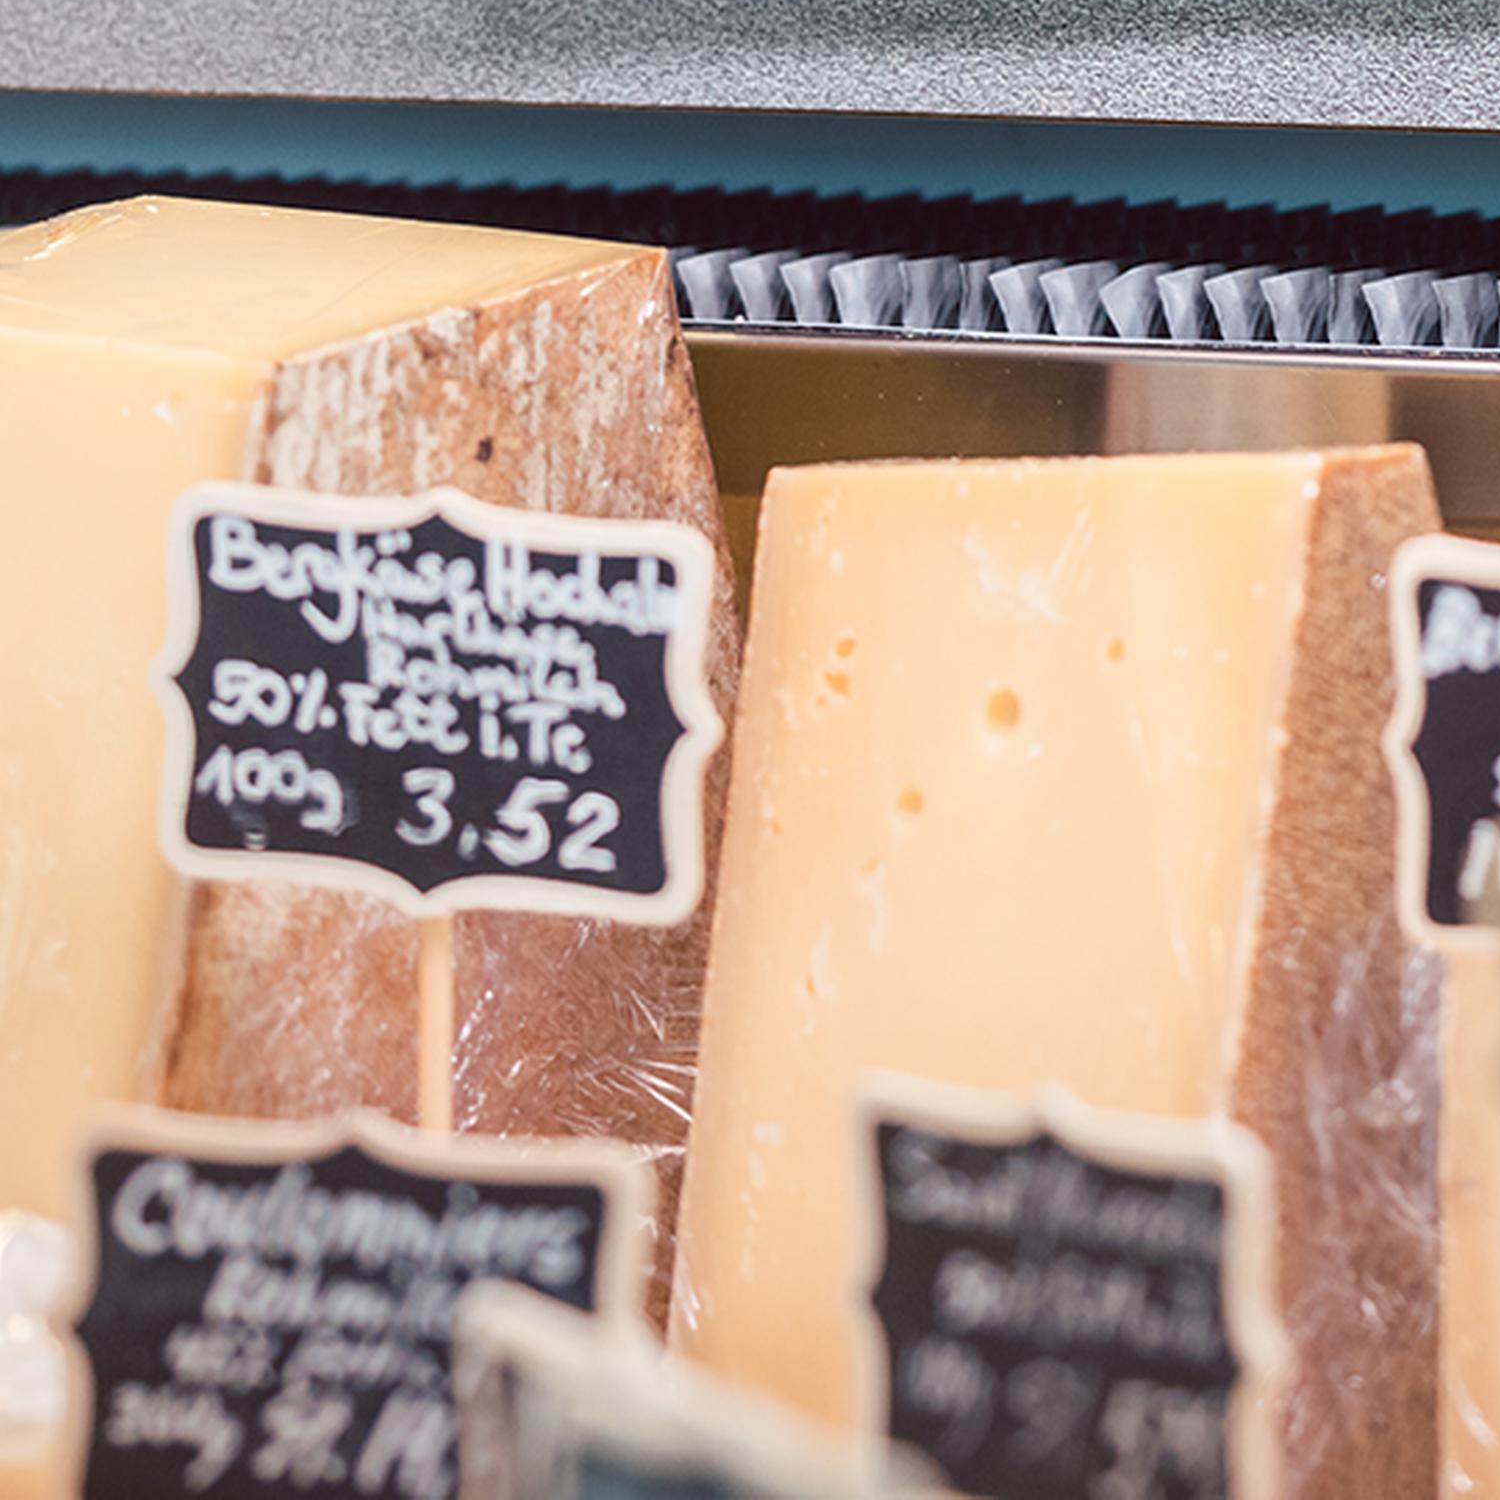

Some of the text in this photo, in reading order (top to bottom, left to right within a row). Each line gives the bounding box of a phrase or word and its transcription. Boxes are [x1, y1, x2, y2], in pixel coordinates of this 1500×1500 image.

[209, 515, 477, 642] Bergkäse
[196, 743, 622, 874] 100g 3,52
